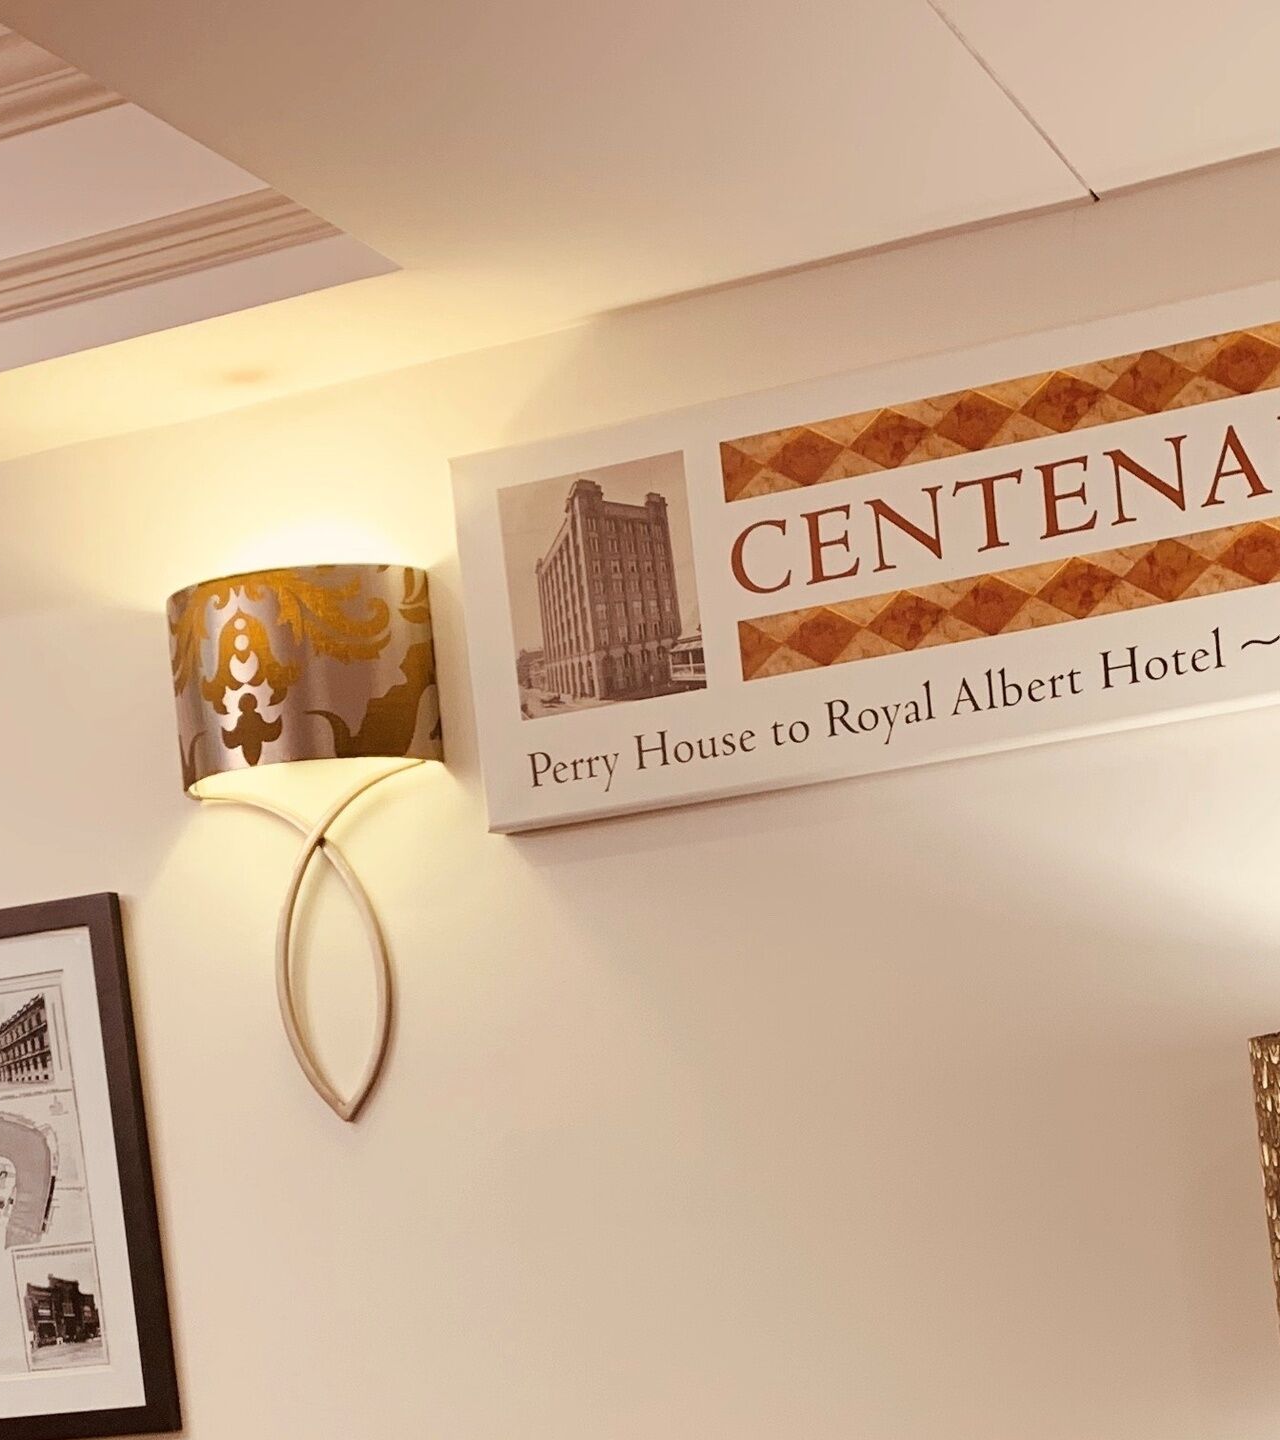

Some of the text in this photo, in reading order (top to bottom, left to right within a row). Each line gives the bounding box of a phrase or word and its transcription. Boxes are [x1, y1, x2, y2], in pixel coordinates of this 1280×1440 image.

[526, 751, 615, 788] Perry
[632, 726, 756, 772] House
[770, 718, 811, 748] to
[823, 684, 937, 745] Royal
[950, 665, 1083, 718] Albert
[1098, 628, 1227, 690] Hotel
